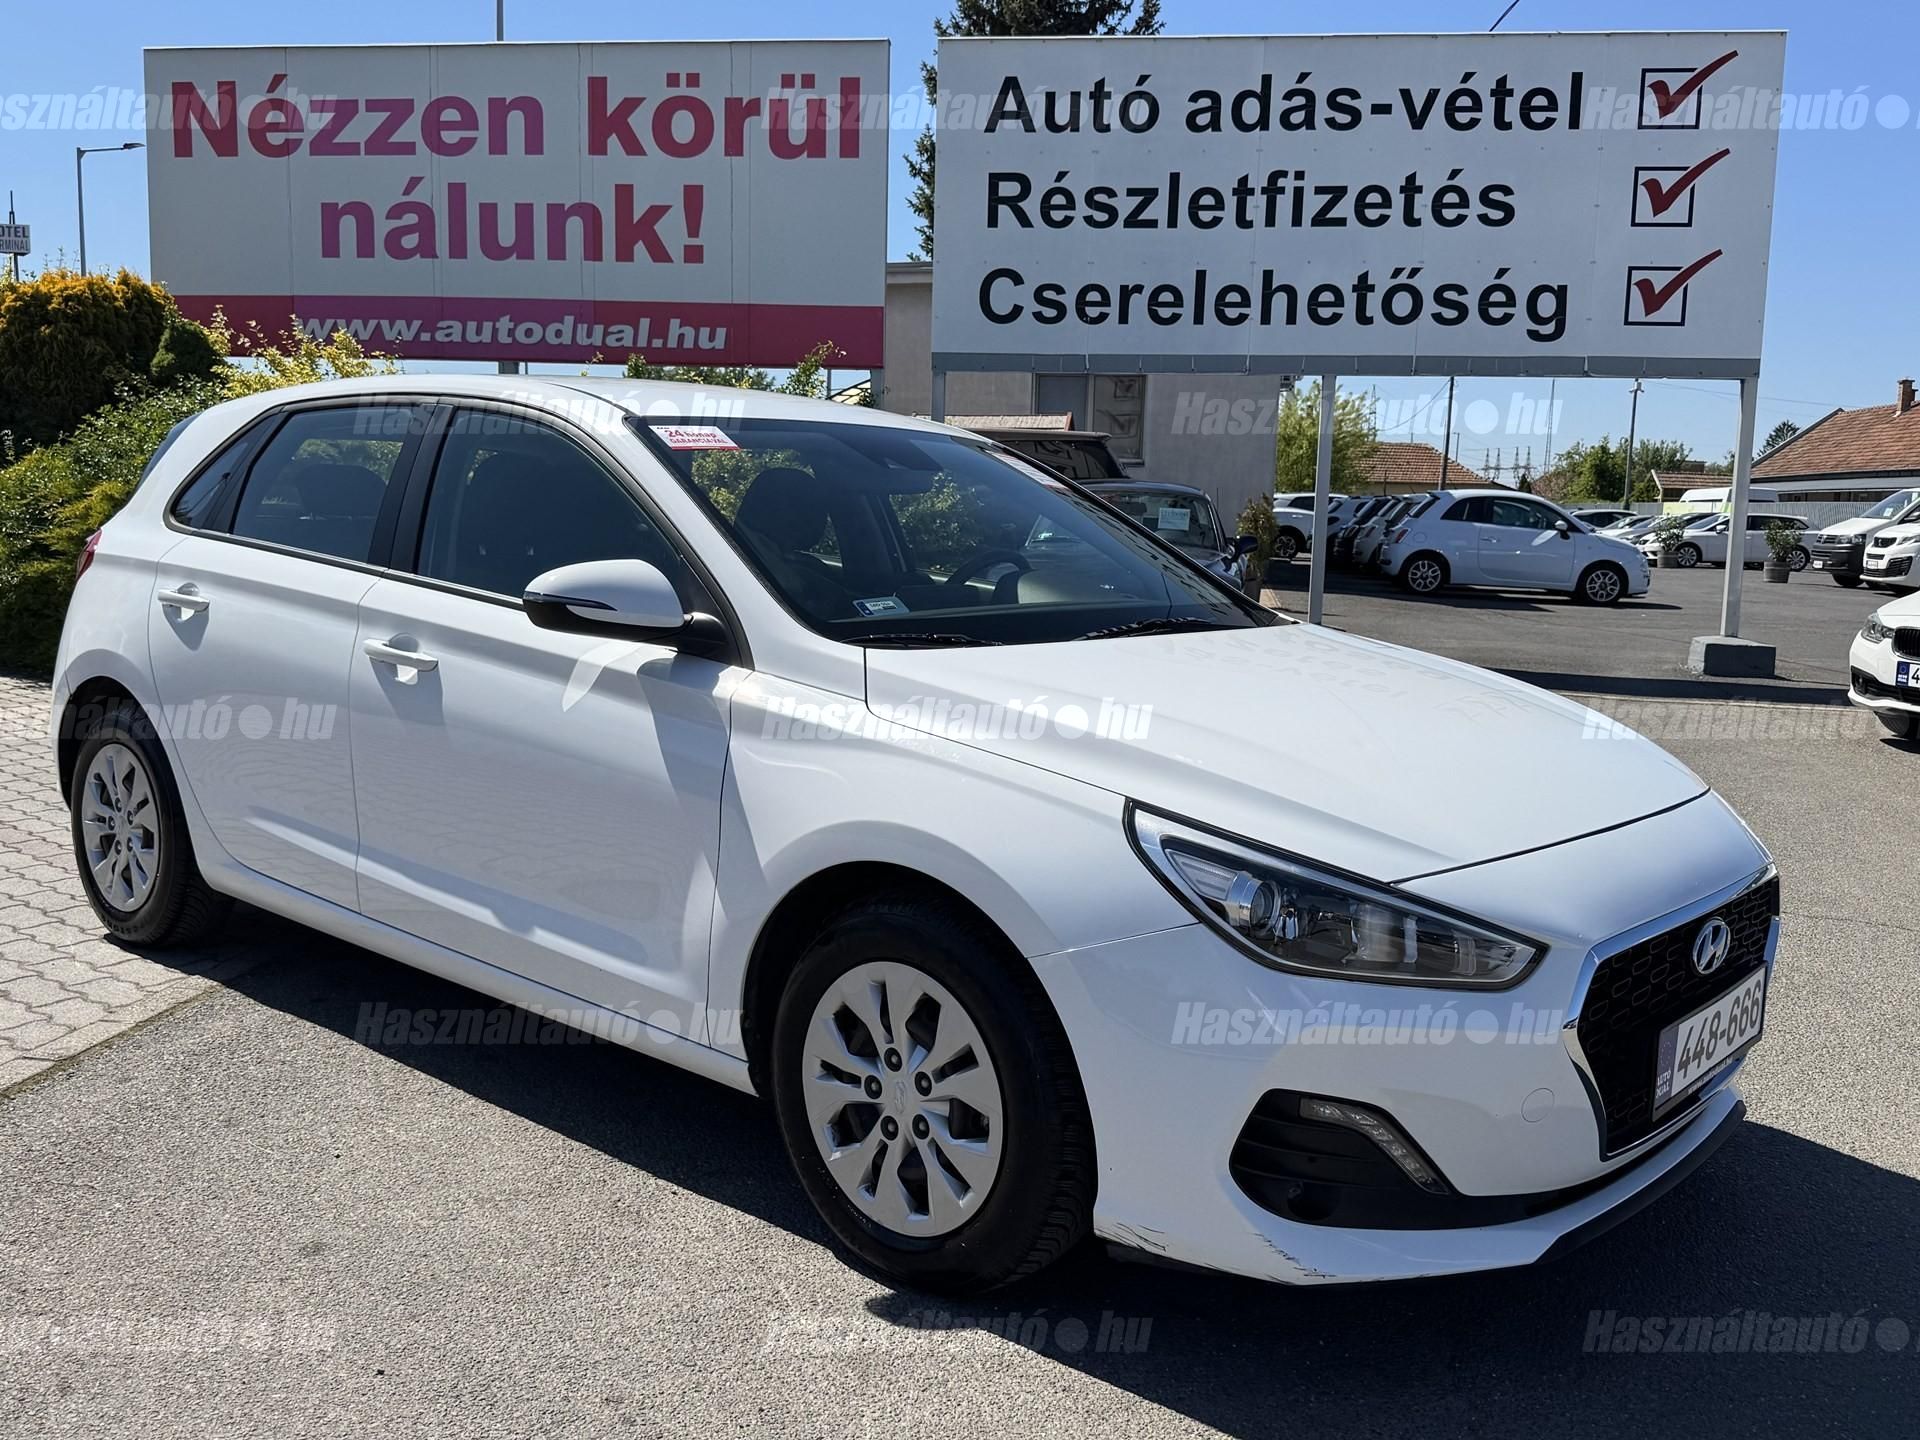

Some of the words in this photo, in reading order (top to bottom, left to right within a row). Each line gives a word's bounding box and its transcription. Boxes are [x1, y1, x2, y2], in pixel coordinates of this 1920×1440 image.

[171, 74, 544, 158] Nézzen
[587, 73, 862, 159] körül
[984, 75, 1159, 133] Autó
[1186, 71, 1583, 132] adás-vétel
[321, 176, 704, 264] nálunk!
[988, 168, 1515, 229] Részletfizetés
[299, 315, 726, 350] www.autodual.hu
[979, 267, 1568, 342] Cserelehetőség
[1677, 979, 1762, 1079] 448-666
